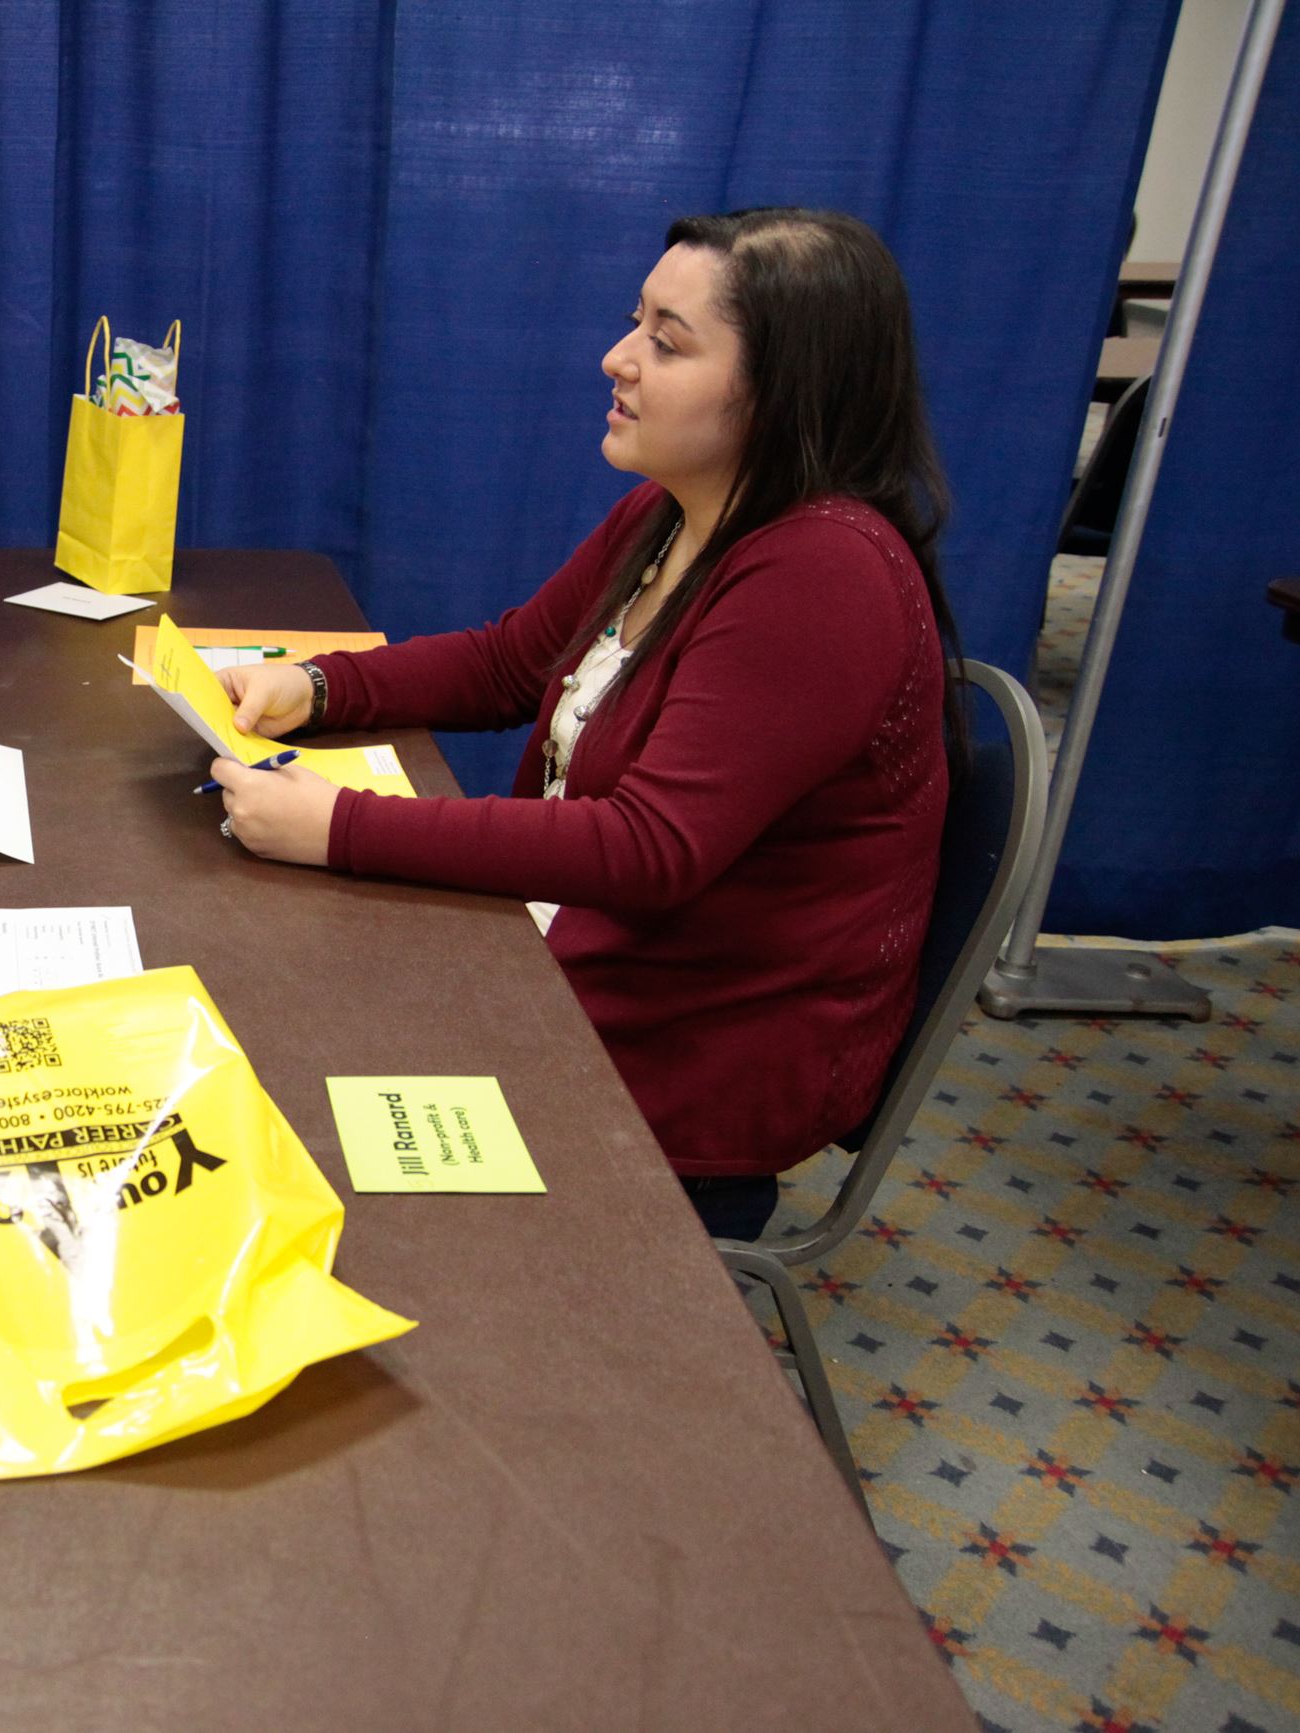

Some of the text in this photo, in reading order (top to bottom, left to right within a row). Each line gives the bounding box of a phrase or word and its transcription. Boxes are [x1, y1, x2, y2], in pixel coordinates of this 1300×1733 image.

[54, 1096, 173, 1120] 25-795-4200
[72, 1115, 176, 1144] CAREER
[378, 1092, 430, 1176] Jill Ranard
[449, 1105, 484, 1164] Health care)
[426, 1112, 460, 1166] (Non-profit
[77, 1162, 96, 1184] is
[116, 1128, 228, 1210] You
